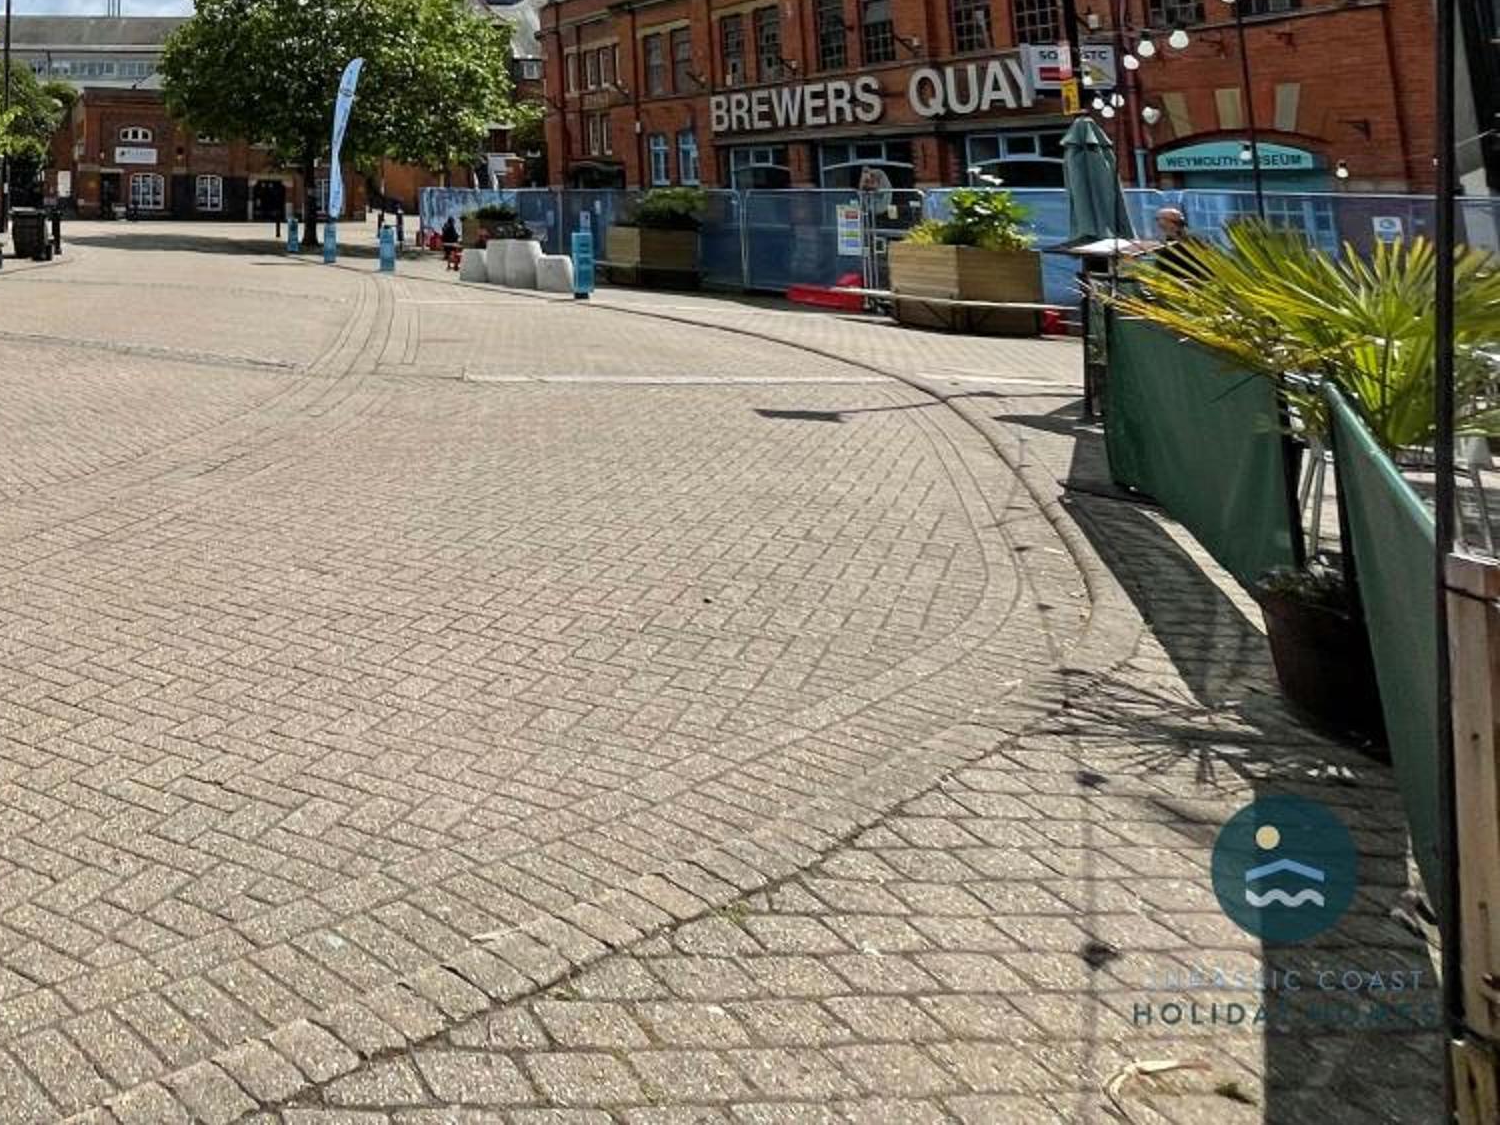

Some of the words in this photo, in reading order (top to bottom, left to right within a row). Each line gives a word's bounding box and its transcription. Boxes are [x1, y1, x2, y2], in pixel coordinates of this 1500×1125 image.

[710, 76, 883, 132] BREWERS
[909, 58, 1034, 117] QUAY
[1165, 155, 1239, 168] WEYMOUTH
[1241, 154, 1302, 166] SEUM
